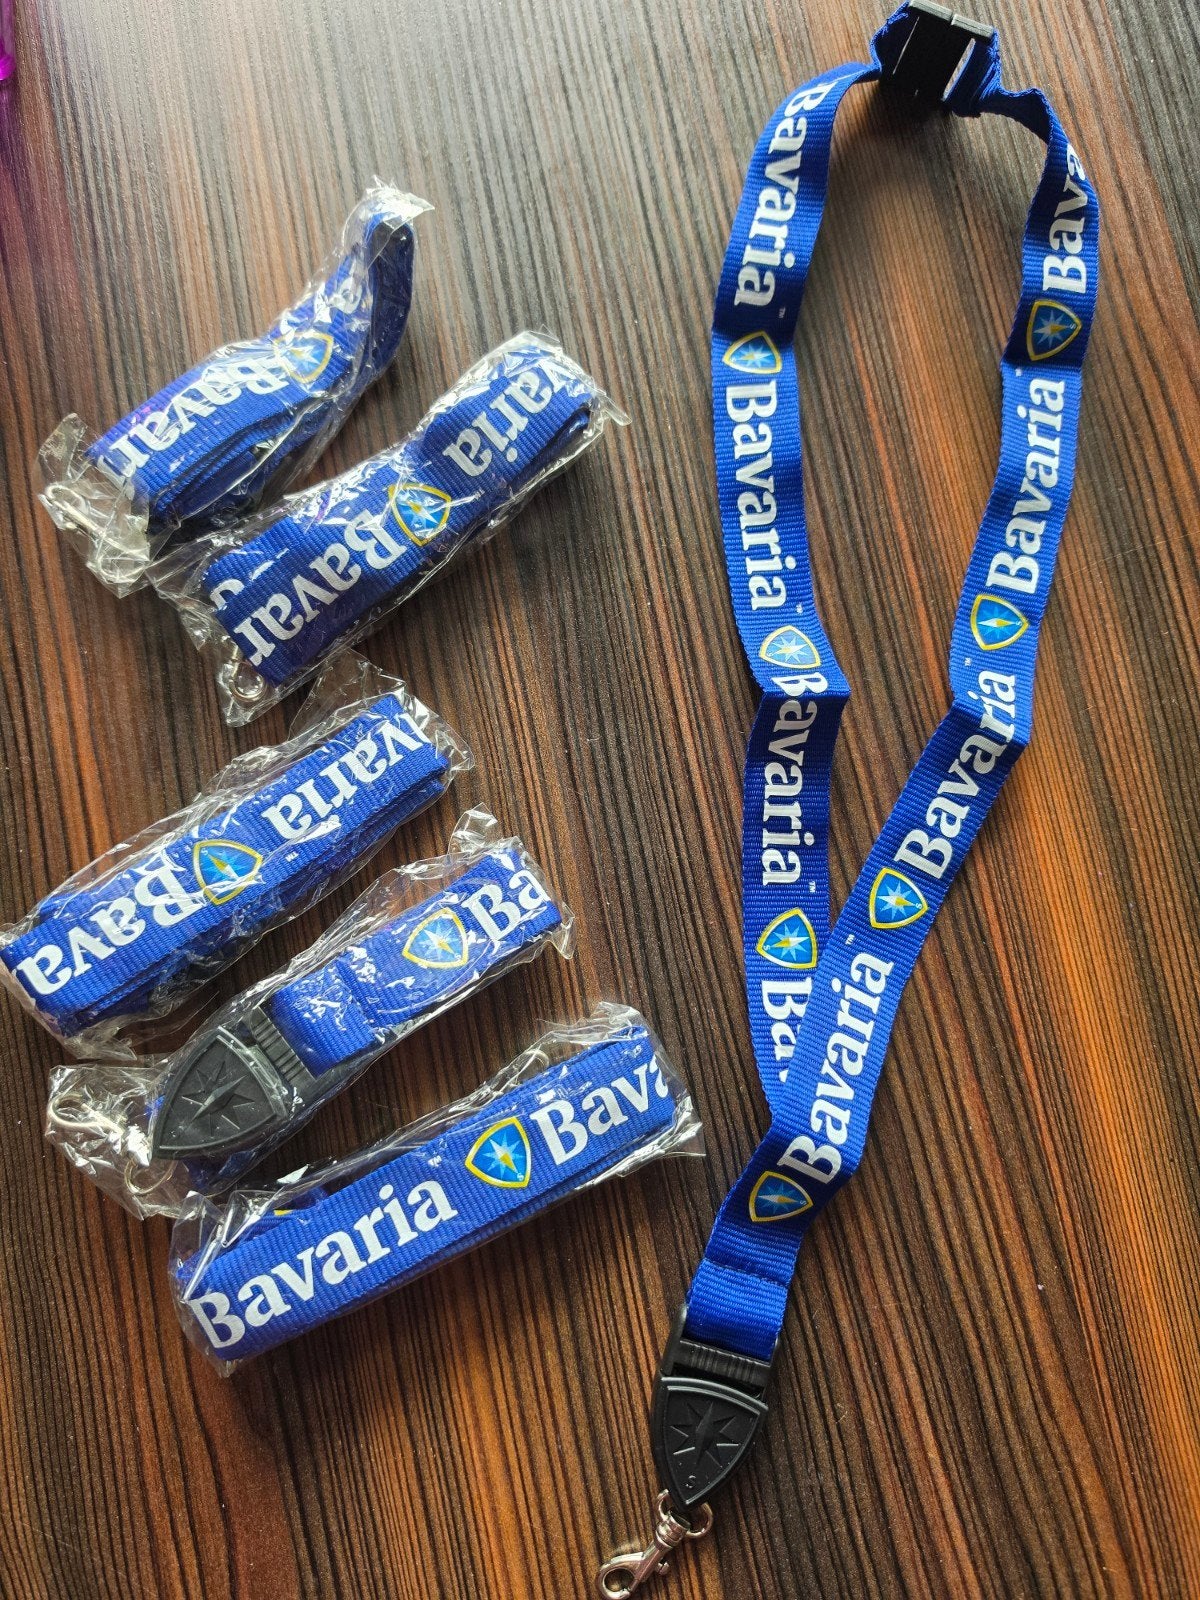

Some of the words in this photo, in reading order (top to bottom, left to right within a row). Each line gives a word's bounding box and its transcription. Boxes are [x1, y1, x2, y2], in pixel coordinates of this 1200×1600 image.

[734, 81, 838, 307] Bavaria
[234, 509, 407, 668] Bavar
[725, 379, 797, 611] Bavaria
[985, 377, 1066, 595] Bavaria
[761, 671, 829, 886] Bavaria
[894, 669, 1017, 880] Bavaria
[15, 851, 206, 997] Bava
[777, 951, 895, 1185] Bavaria
[191, 1178, 458, 1350] Bavaria
